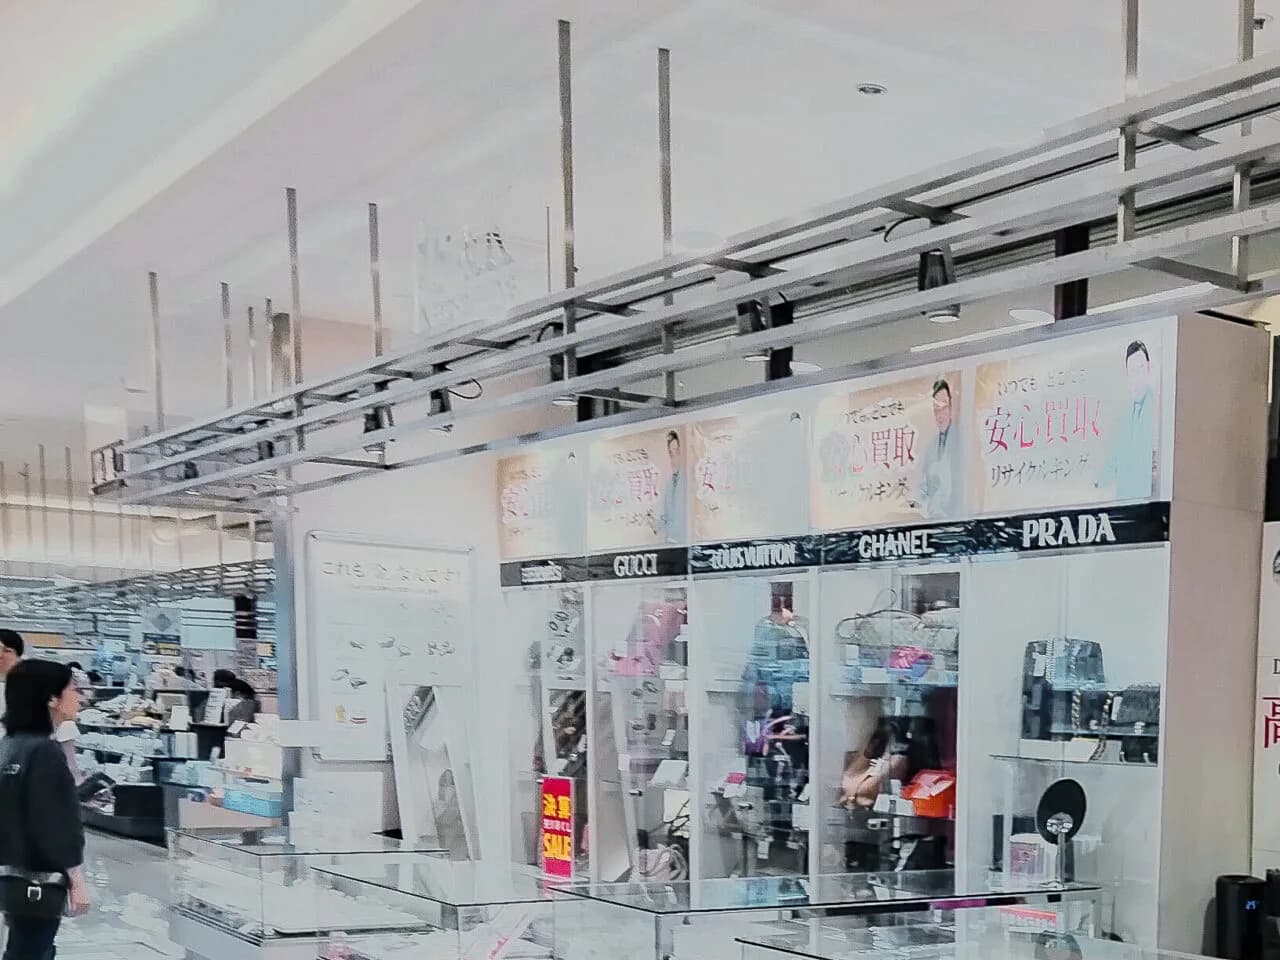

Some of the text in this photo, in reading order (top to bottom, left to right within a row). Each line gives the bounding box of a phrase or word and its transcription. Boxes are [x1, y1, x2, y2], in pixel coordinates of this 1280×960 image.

[1022, 512, 1116, 547] PRADA
[858, 530, 935, 559] CHANEL
[613, 553, 659, 577] GUCCI
